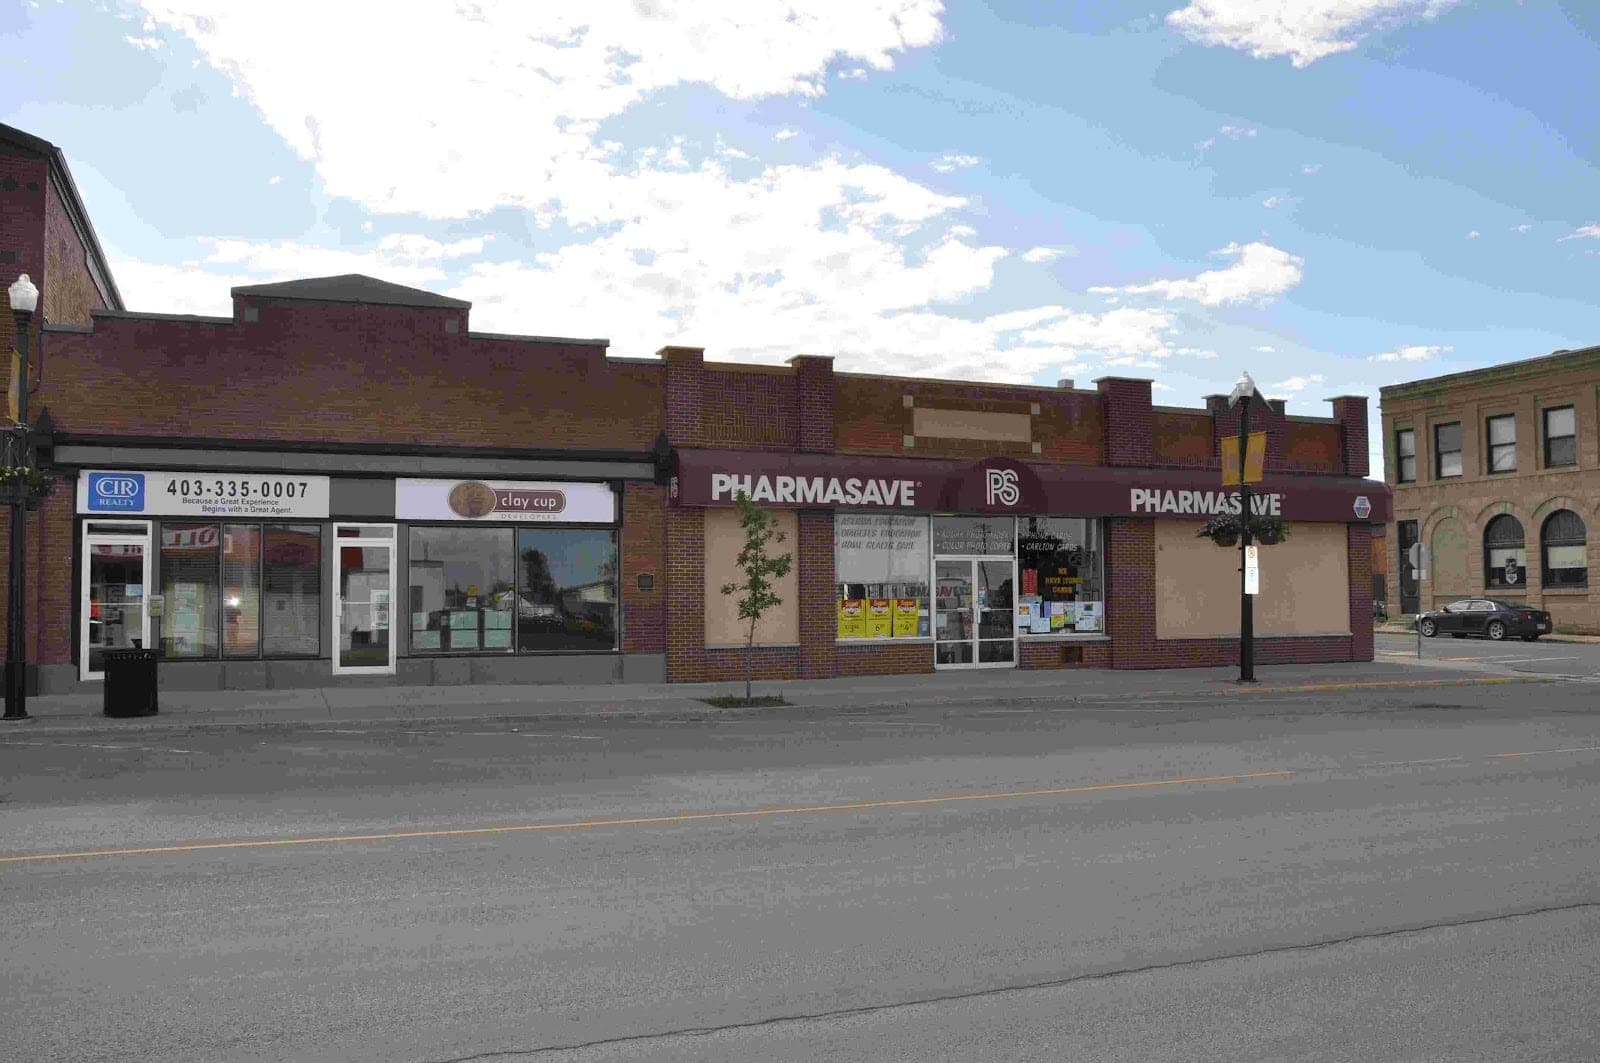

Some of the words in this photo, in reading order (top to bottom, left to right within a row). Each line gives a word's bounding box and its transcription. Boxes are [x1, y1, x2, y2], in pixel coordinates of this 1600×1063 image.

[99, 479, 135, 496] CIR
[166, 479, 308, 498] 403-335-0007
[711, 473, 915, 506] PHARMASAVE
[986, 468, 1020, 506] PS
[99, 498, 135, 506] REALTY
[182, 497, 213, 505] Because
[241, 498, 280, 507] Experience
[202, 505, 226, 514] Begins
[501, 492, 529, 509] clay
[533, 498, 557, 510] cup
[1026, 543, 1055, 552] CARLTON
